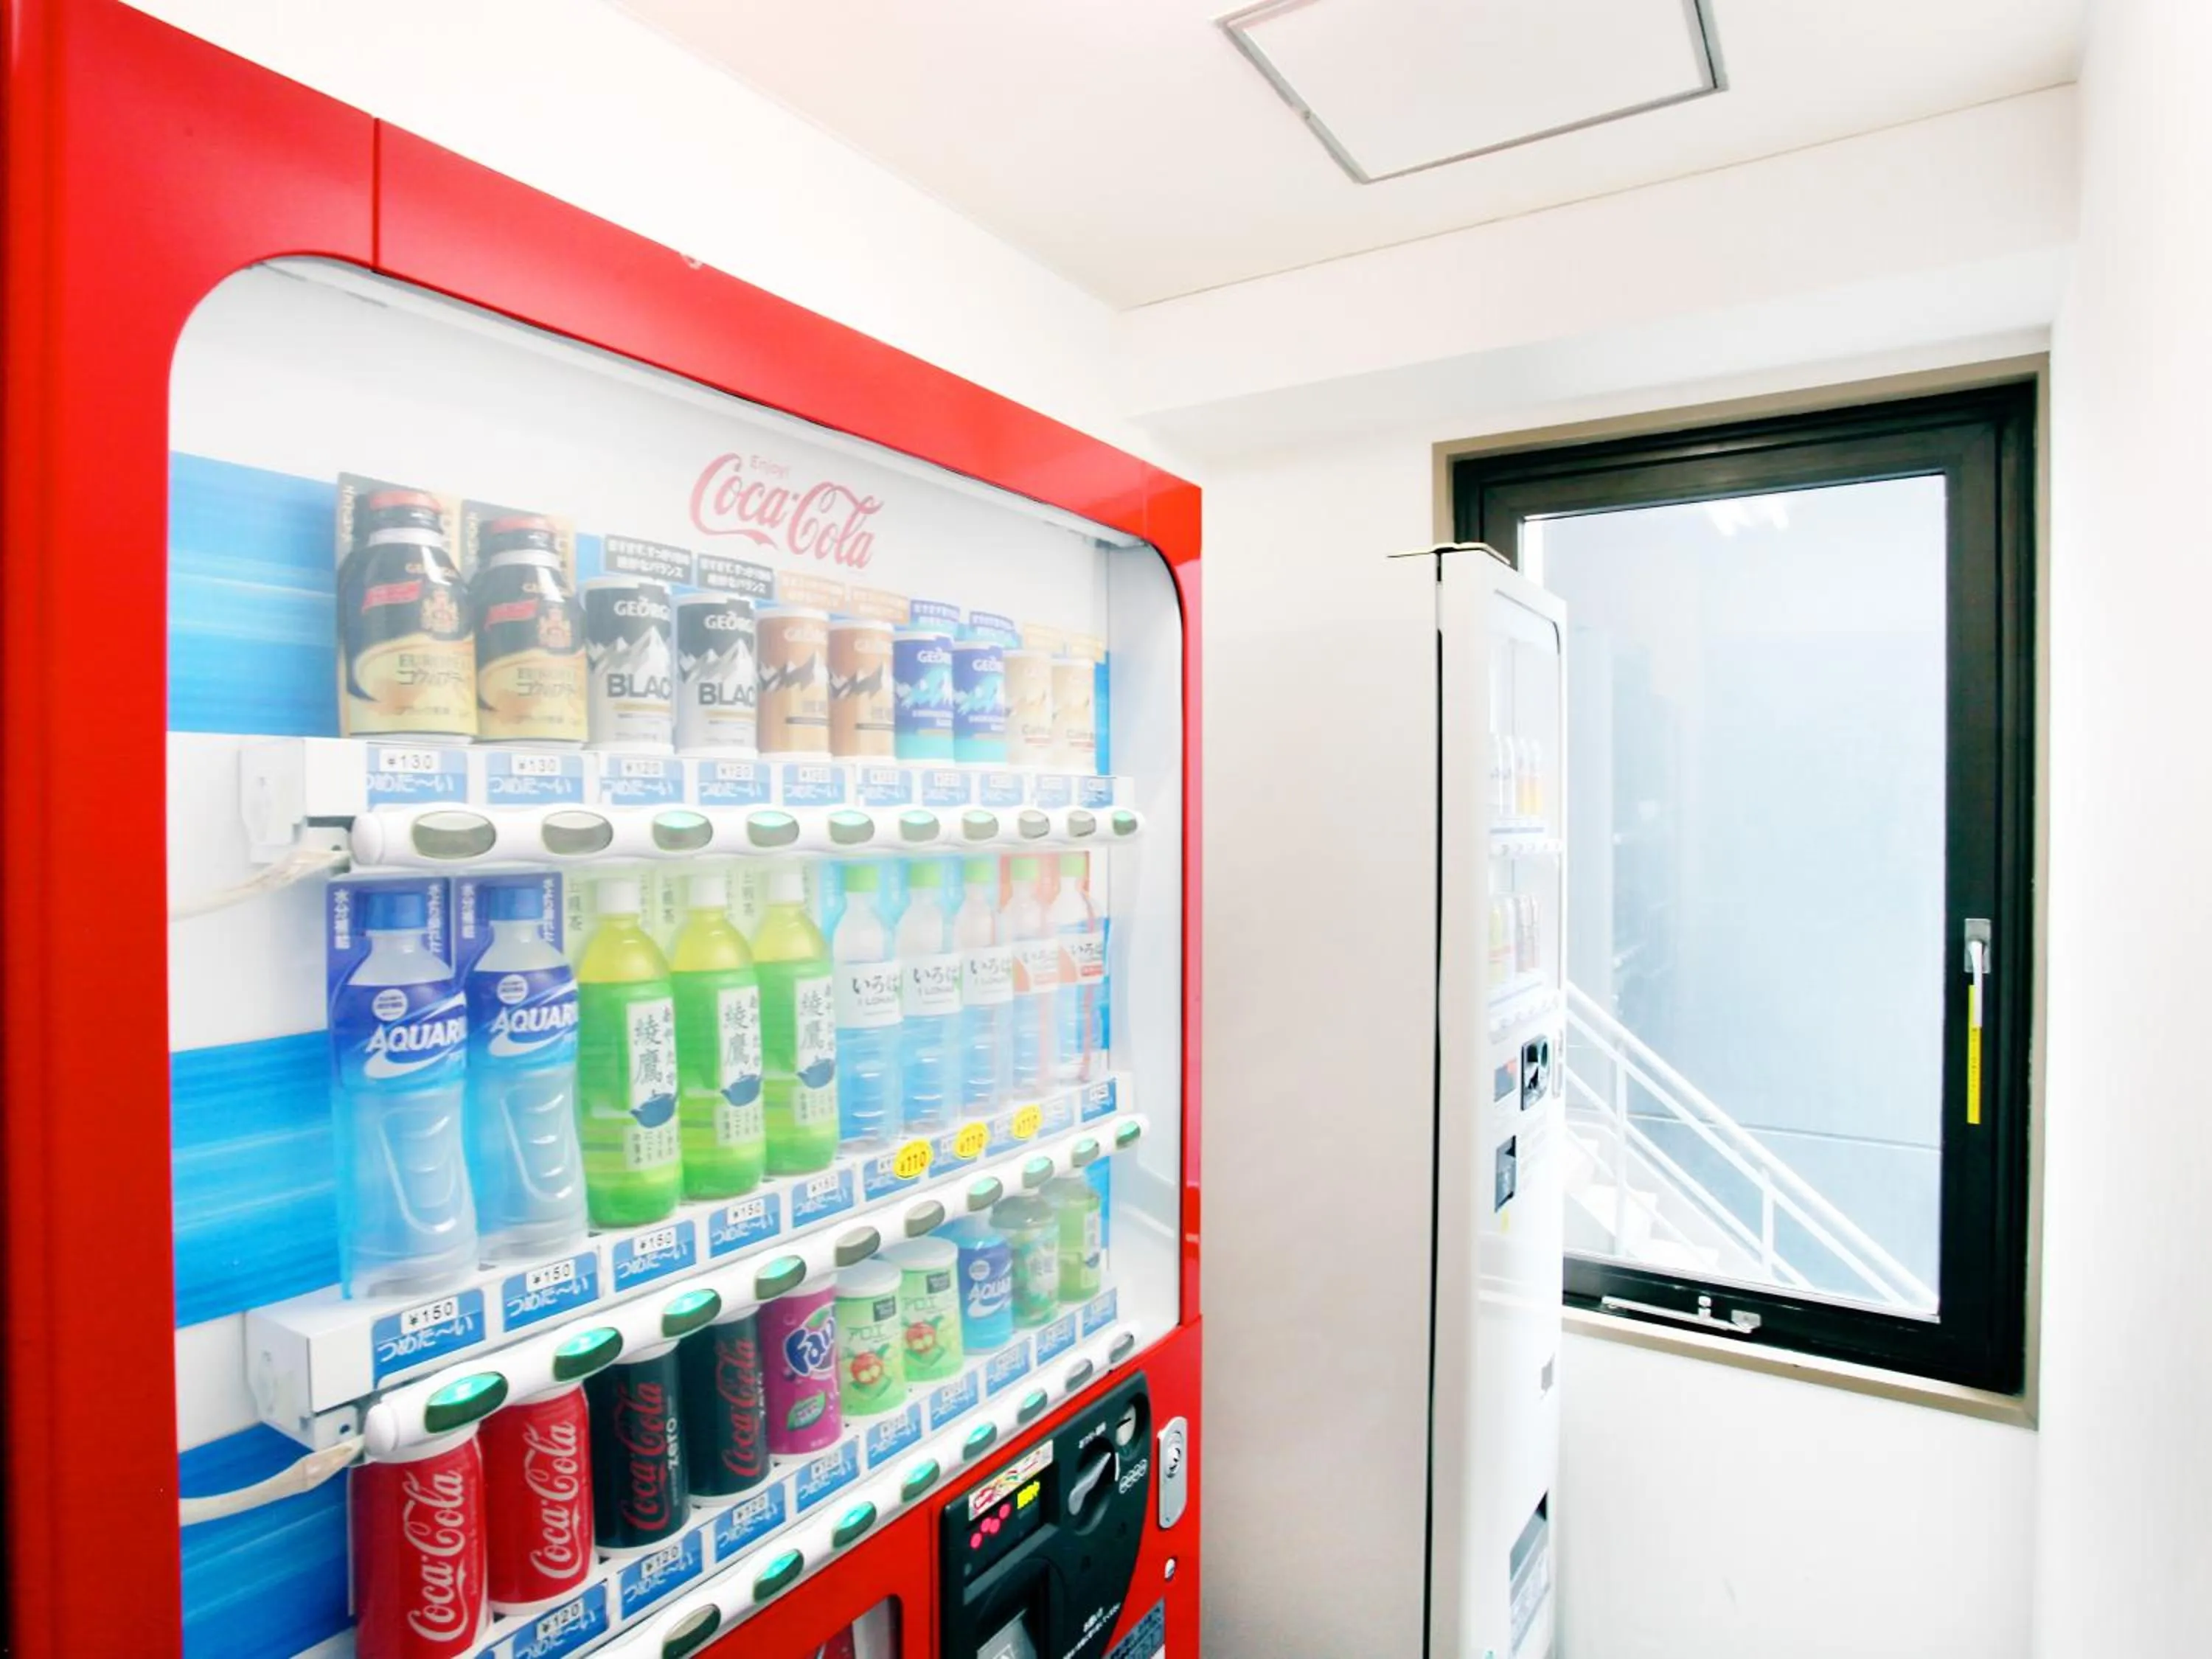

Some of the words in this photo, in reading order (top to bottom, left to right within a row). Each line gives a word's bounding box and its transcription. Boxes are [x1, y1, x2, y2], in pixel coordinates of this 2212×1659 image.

[689, 453, 884, 569] Coca-Cola
[408, 1301, 454, 1327] ¥150
[532, 1263, 571, 1284] ¥150
[667, 1417, 679, 1470] zero
[523, 1420, 583, 1578] Coca-Cola
[403, 1470, 468, 1641] Coca-Cola
